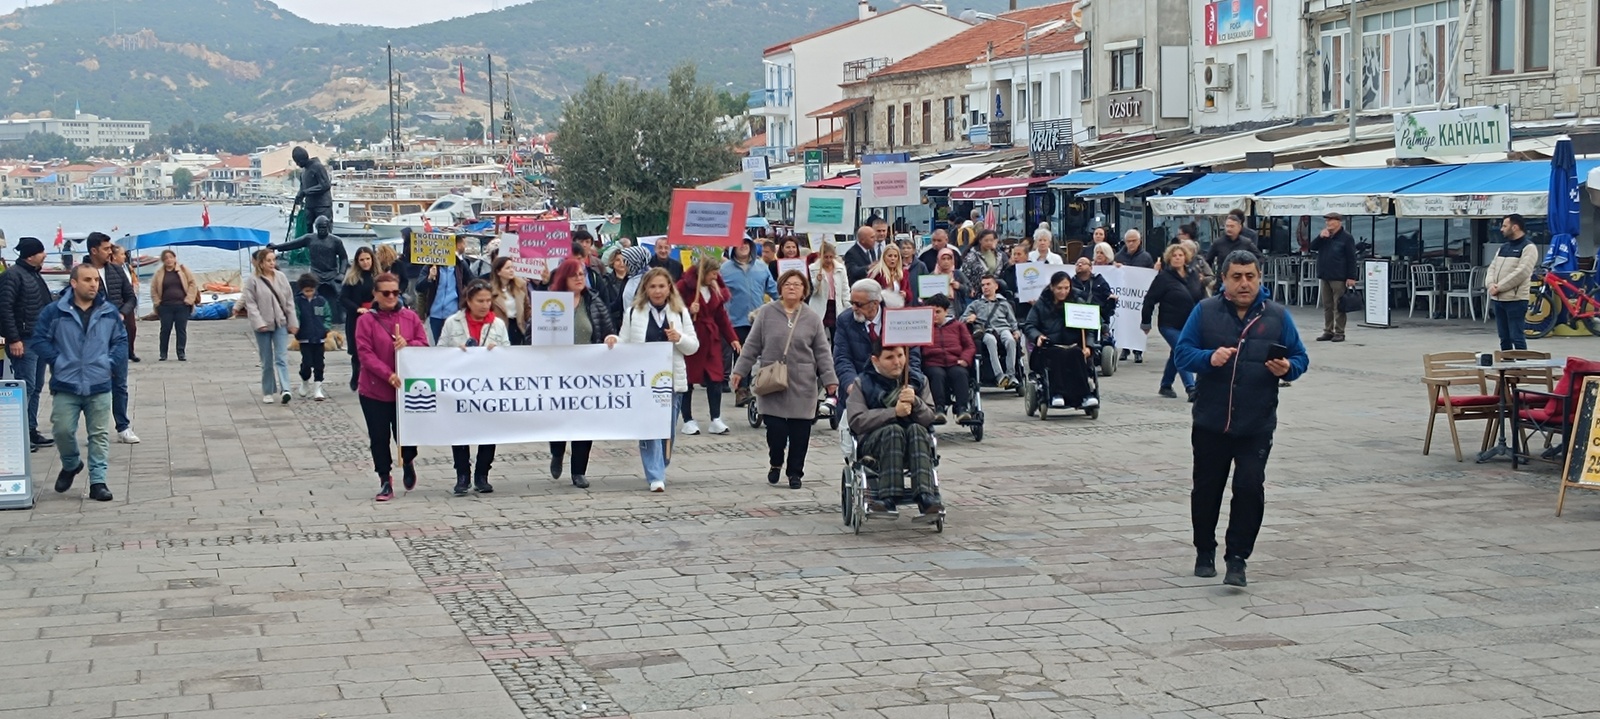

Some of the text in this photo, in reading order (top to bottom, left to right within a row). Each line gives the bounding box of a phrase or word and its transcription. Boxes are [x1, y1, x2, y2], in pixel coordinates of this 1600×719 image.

[1108, 97, 1141, 119] ÖZSÜT
[1401, 120, 1501, 152] Palmiye KAHVALTI
[425, 240, 438, 248] SUÇ
[430, 248, 450, 256] SEÇİM
[417, 255, 446, 264] DEĞİLDİR
[440, 370, 646, 395] FOÇA KENT KONSEYİ
[456, 392, 632, 413] ENGELLİ MECLİSİ
